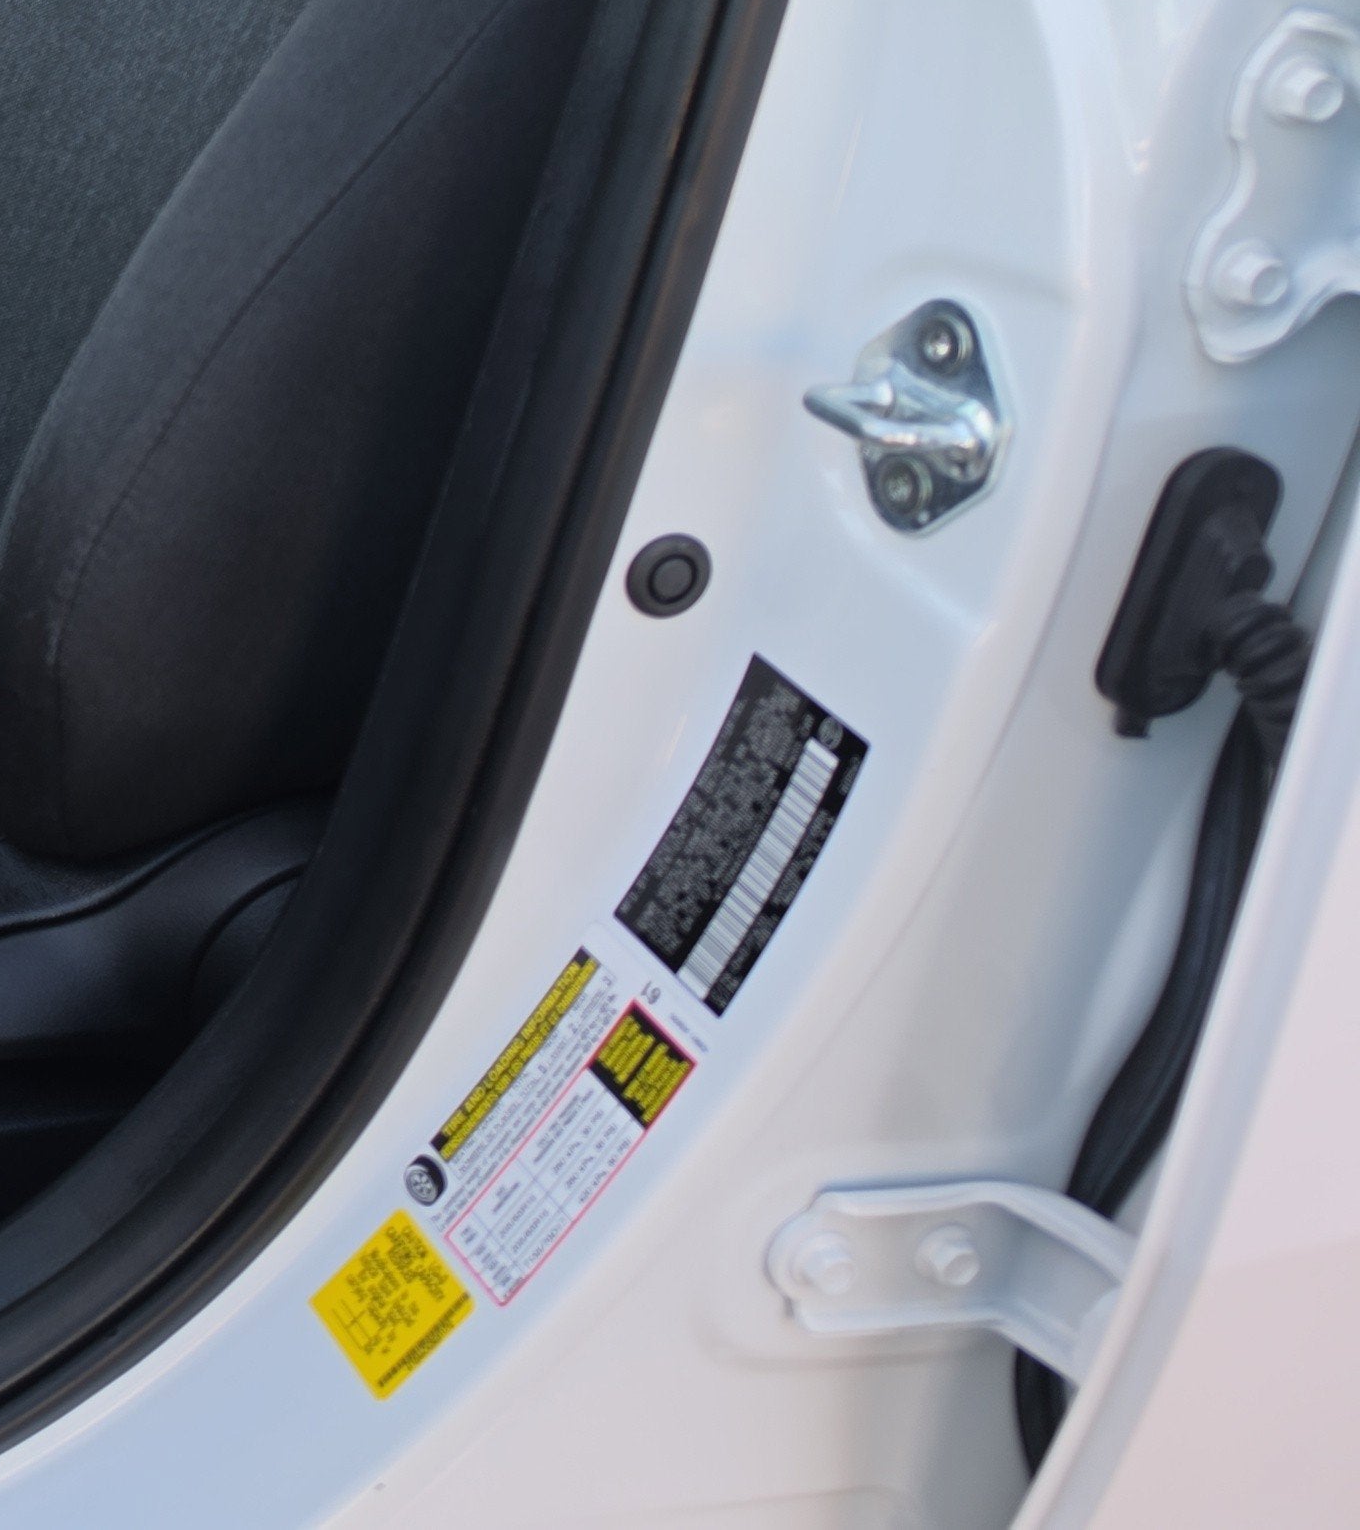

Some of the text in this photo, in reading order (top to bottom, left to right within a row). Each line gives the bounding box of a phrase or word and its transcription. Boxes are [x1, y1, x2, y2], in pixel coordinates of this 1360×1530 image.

[440, 959, 582, 1137] TIRE AND LOADING INFORMATION
